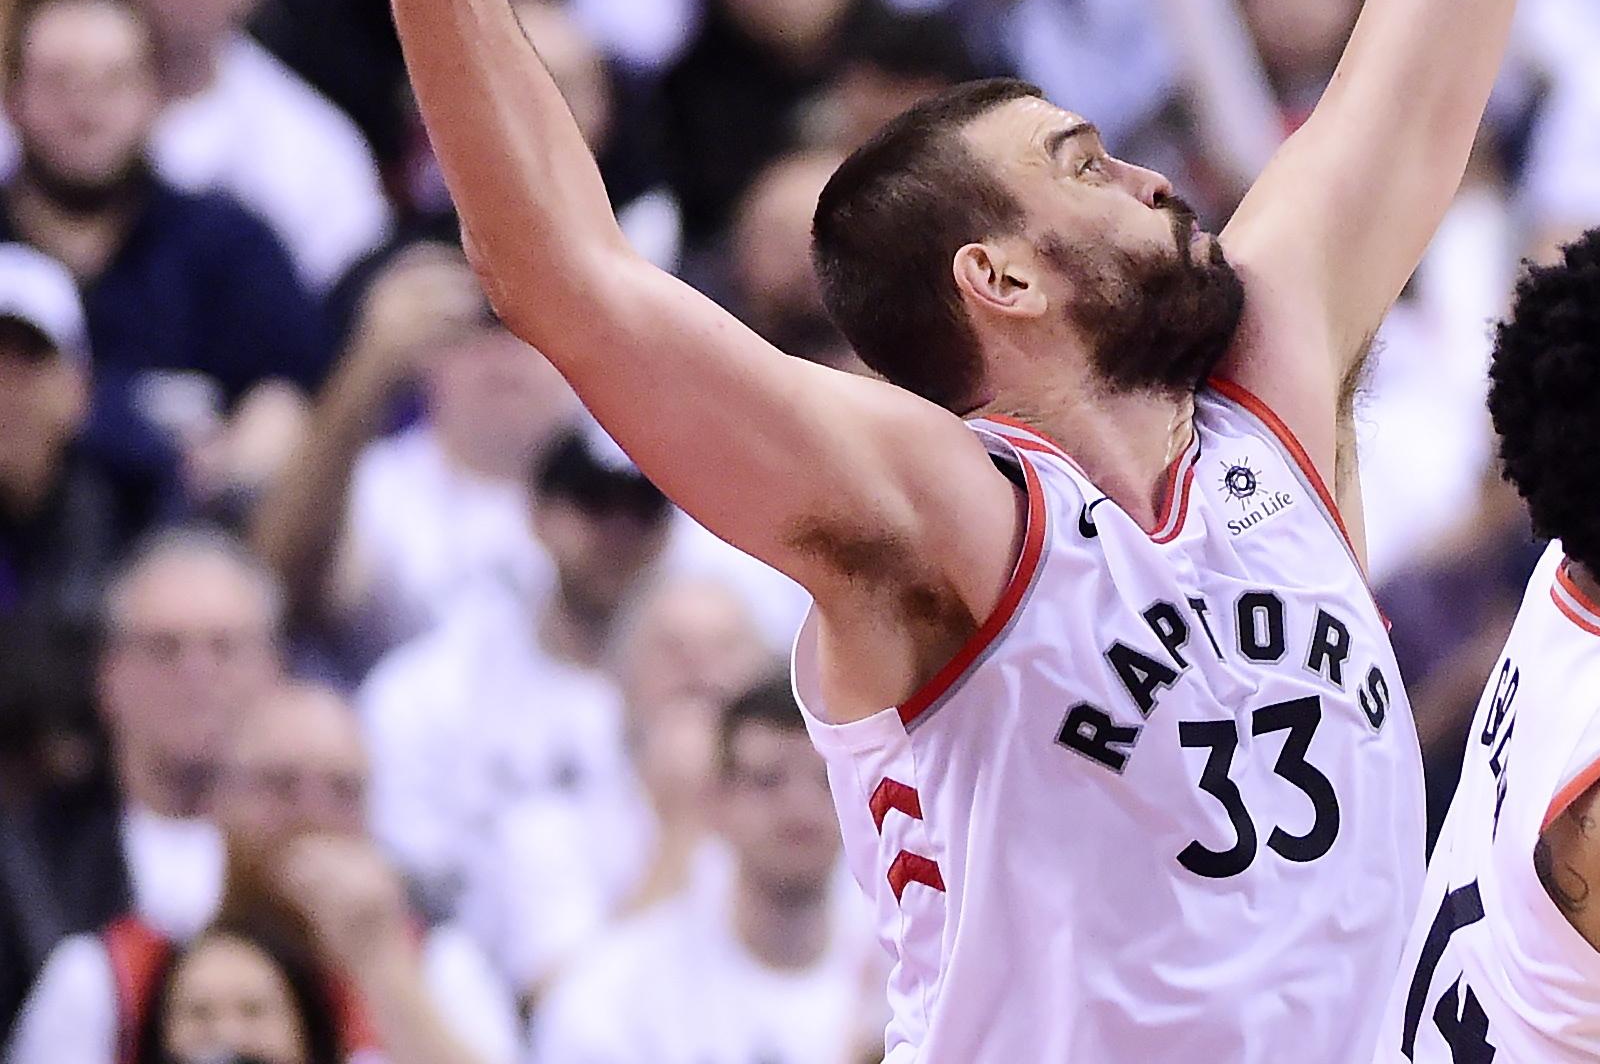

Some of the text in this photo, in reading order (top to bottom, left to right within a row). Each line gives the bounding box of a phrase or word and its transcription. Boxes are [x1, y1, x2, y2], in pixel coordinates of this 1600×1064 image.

[1227, 491, 1293, 536] Sun Life
[1055, 589, 1391, 775] RAPTORS
[1176, 695, 1340, 878] 33
